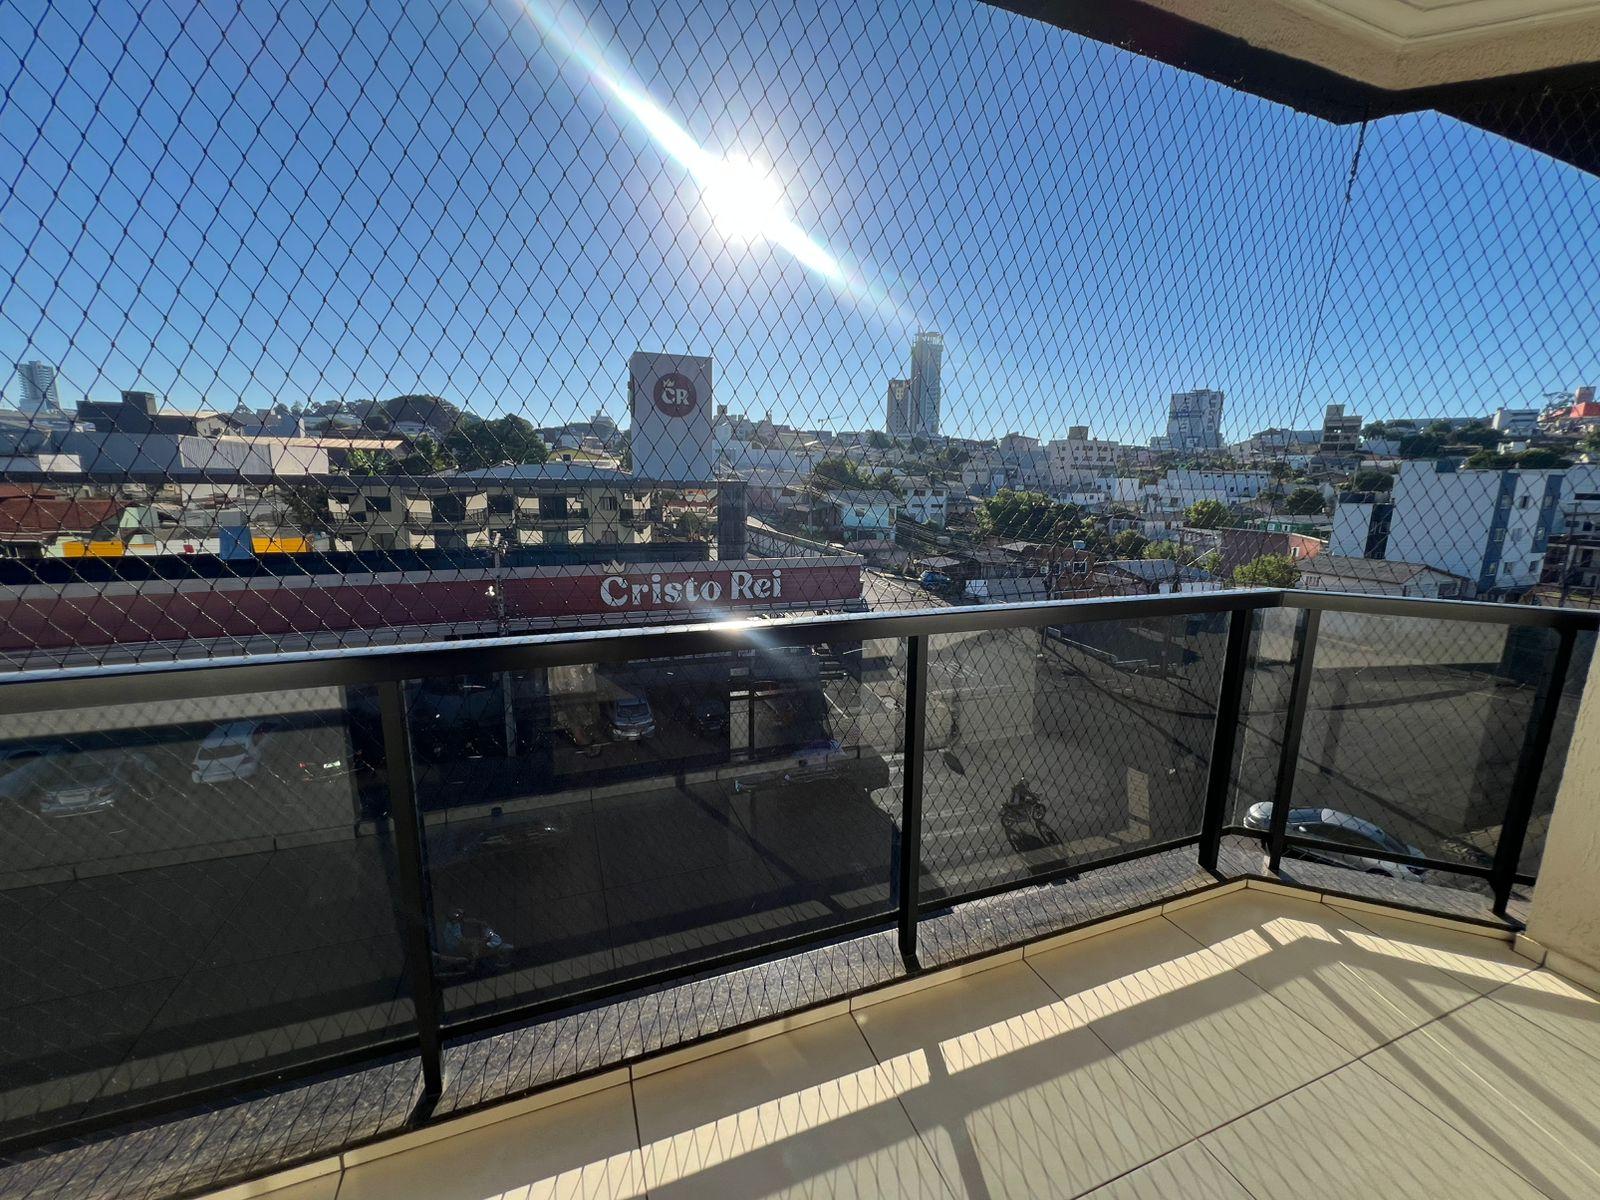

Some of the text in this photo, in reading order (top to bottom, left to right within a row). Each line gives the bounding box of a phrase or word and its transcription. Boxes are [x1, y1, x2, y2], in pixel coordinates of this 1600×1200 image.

[661, 387, 689, 406] CR
[600, 569, 782, 607] Cristo Rei
